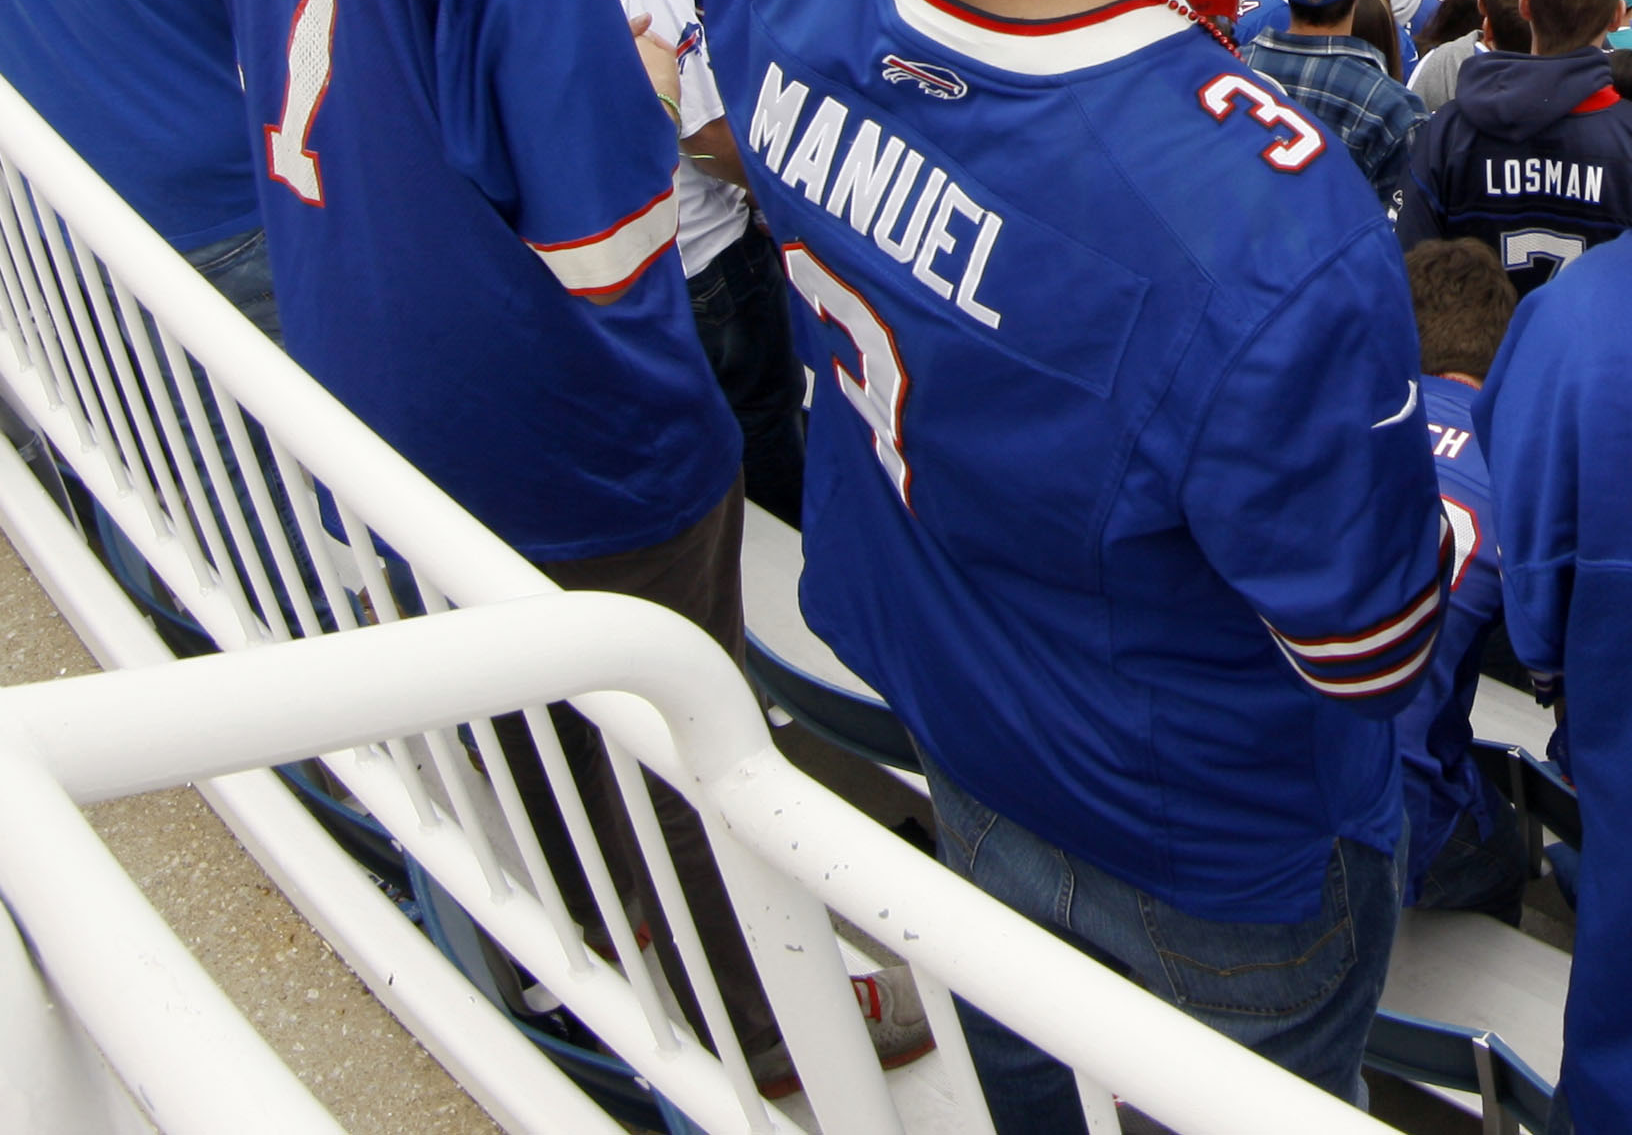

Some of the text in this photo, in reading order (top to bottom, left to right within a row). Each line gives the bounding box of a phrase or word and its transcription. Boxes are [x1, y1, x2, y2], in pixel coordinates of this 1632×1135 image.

[1198, 73, 1327, 172] 3
[749, 61, 1003, 330] MANUEL
[1486, 158, 1603, 203] LOSMAN
